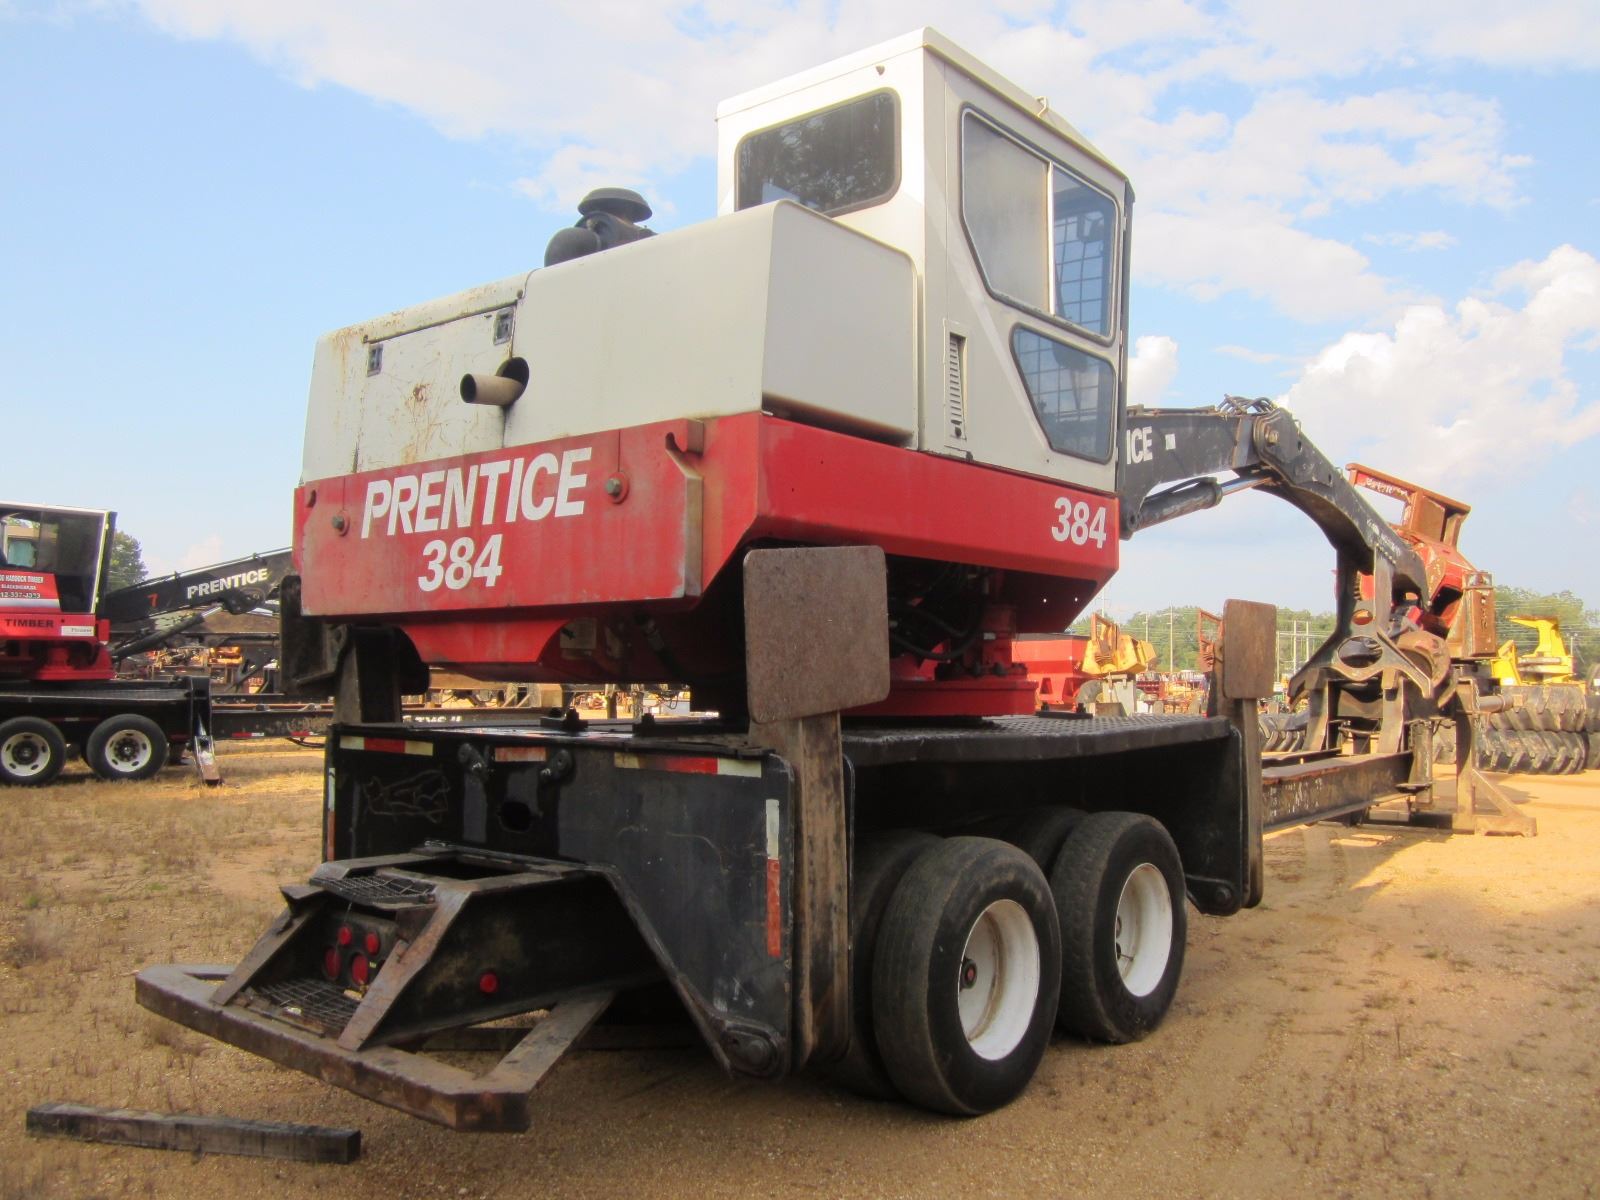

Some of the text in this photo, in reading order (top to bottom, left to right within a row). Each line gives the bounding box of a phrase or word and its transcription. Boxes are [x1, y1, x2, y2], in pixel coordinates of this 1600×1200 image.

[361, 446, 592, 539] PRENTICE
[1051, 496, 1107, 549] 384
[186, 567, 269, 600] PRENTICE
[418, 534, 503, 592] 384
[5, 618, 54, 628] TIMBER
